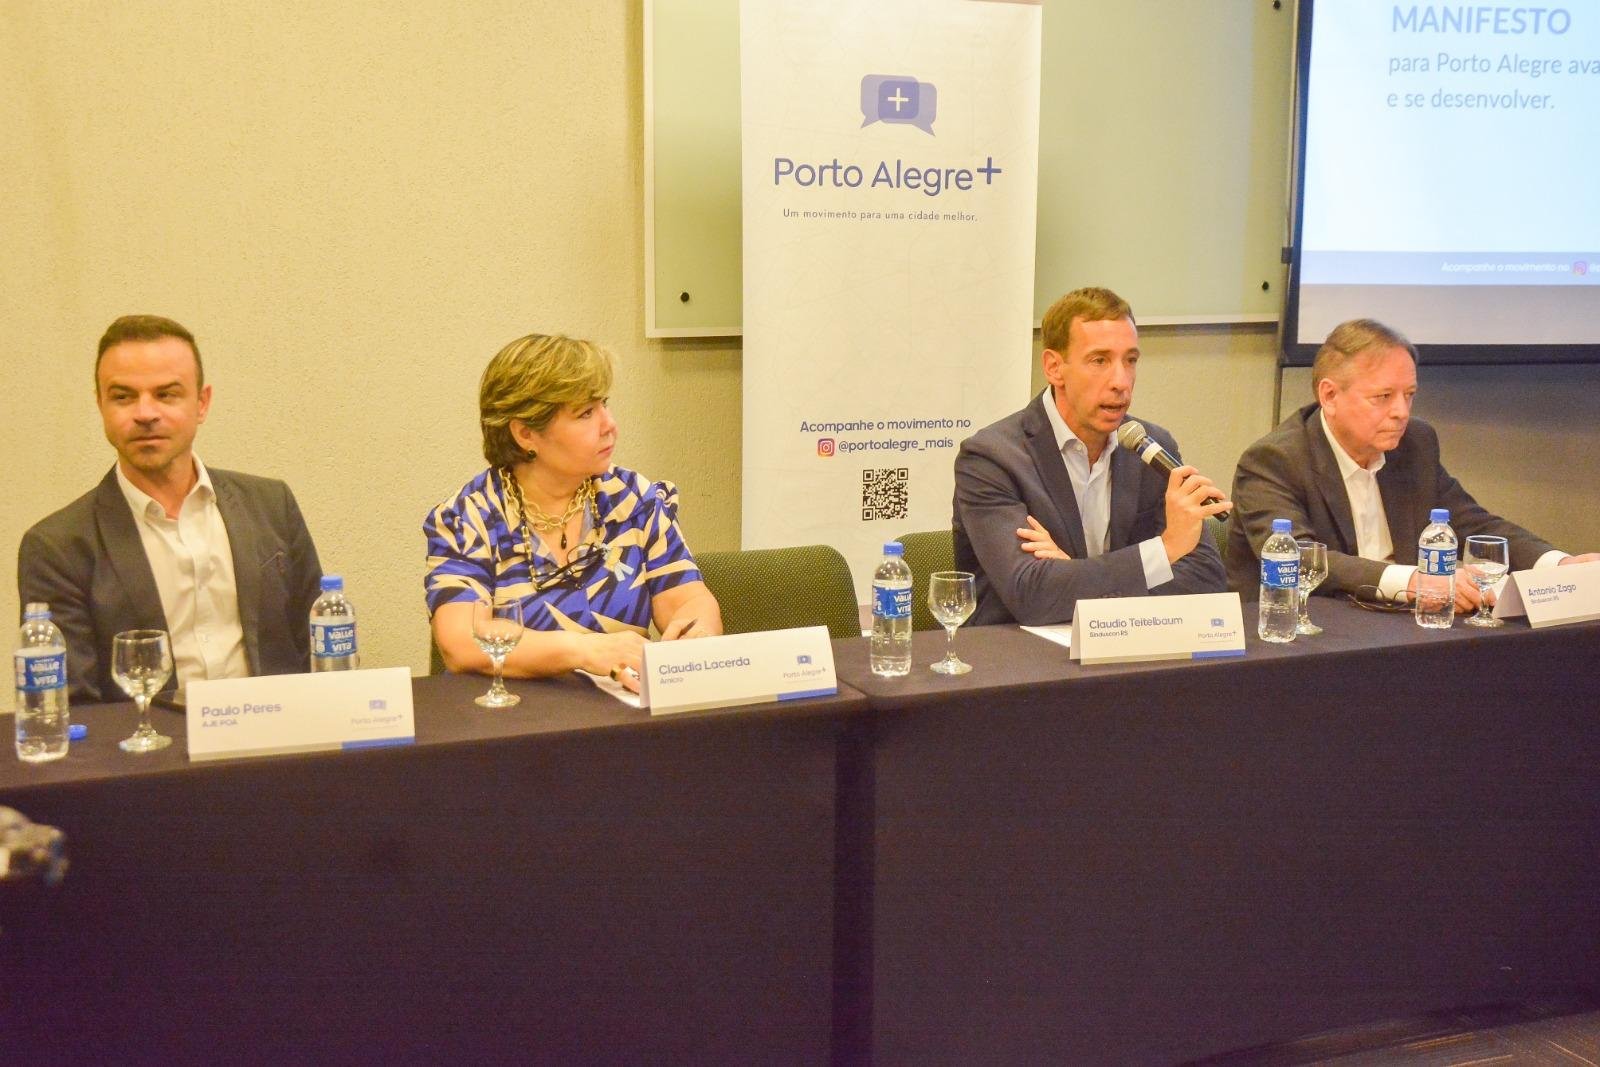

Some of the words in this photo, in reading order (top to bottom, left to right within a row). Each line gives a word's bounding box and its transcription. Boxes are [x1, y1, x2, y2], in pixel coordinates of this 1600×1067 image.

[1392, 5, 1572, 36] MANIFESTO
[1389, 56, 1430, 76] para
[1437, 52, 1491, 73] Porto
[1497, 54, 1562, 78] Alegre
[1387, 92, 1398, 108] e
[1404, 92, 1425, 108] se
[1431, 88, 1555, 110] desenvolver.
[774, 157, 863, 188] Porto
[783, 208, 799, 218] Um
[803, 209, 857, 220] movimento
[860, 211, 882, 222] para
[885, 211, 905, 220] uma
[908, 210, 940, 221] cidade
[943, 210, 978, 222] melhor.
[800, 420, 875, 434] Acompanhe
[877, 421, 885, 430] o
[887, 418, 954, 430] movimento
[956, 418, 971, 428] no
[838, 437, 954, 454] @portoalegre_mais
[1089, 618, 1127, 630] Claudio
[1129, 616, 1183, 628] Teitelbaum
[659, 662, 702, 676] Claudia
[704, 656, 750, 670] Lacerda
[201, 704, 240, 718] Paulo
[243, 702, 282, 715] Peres
